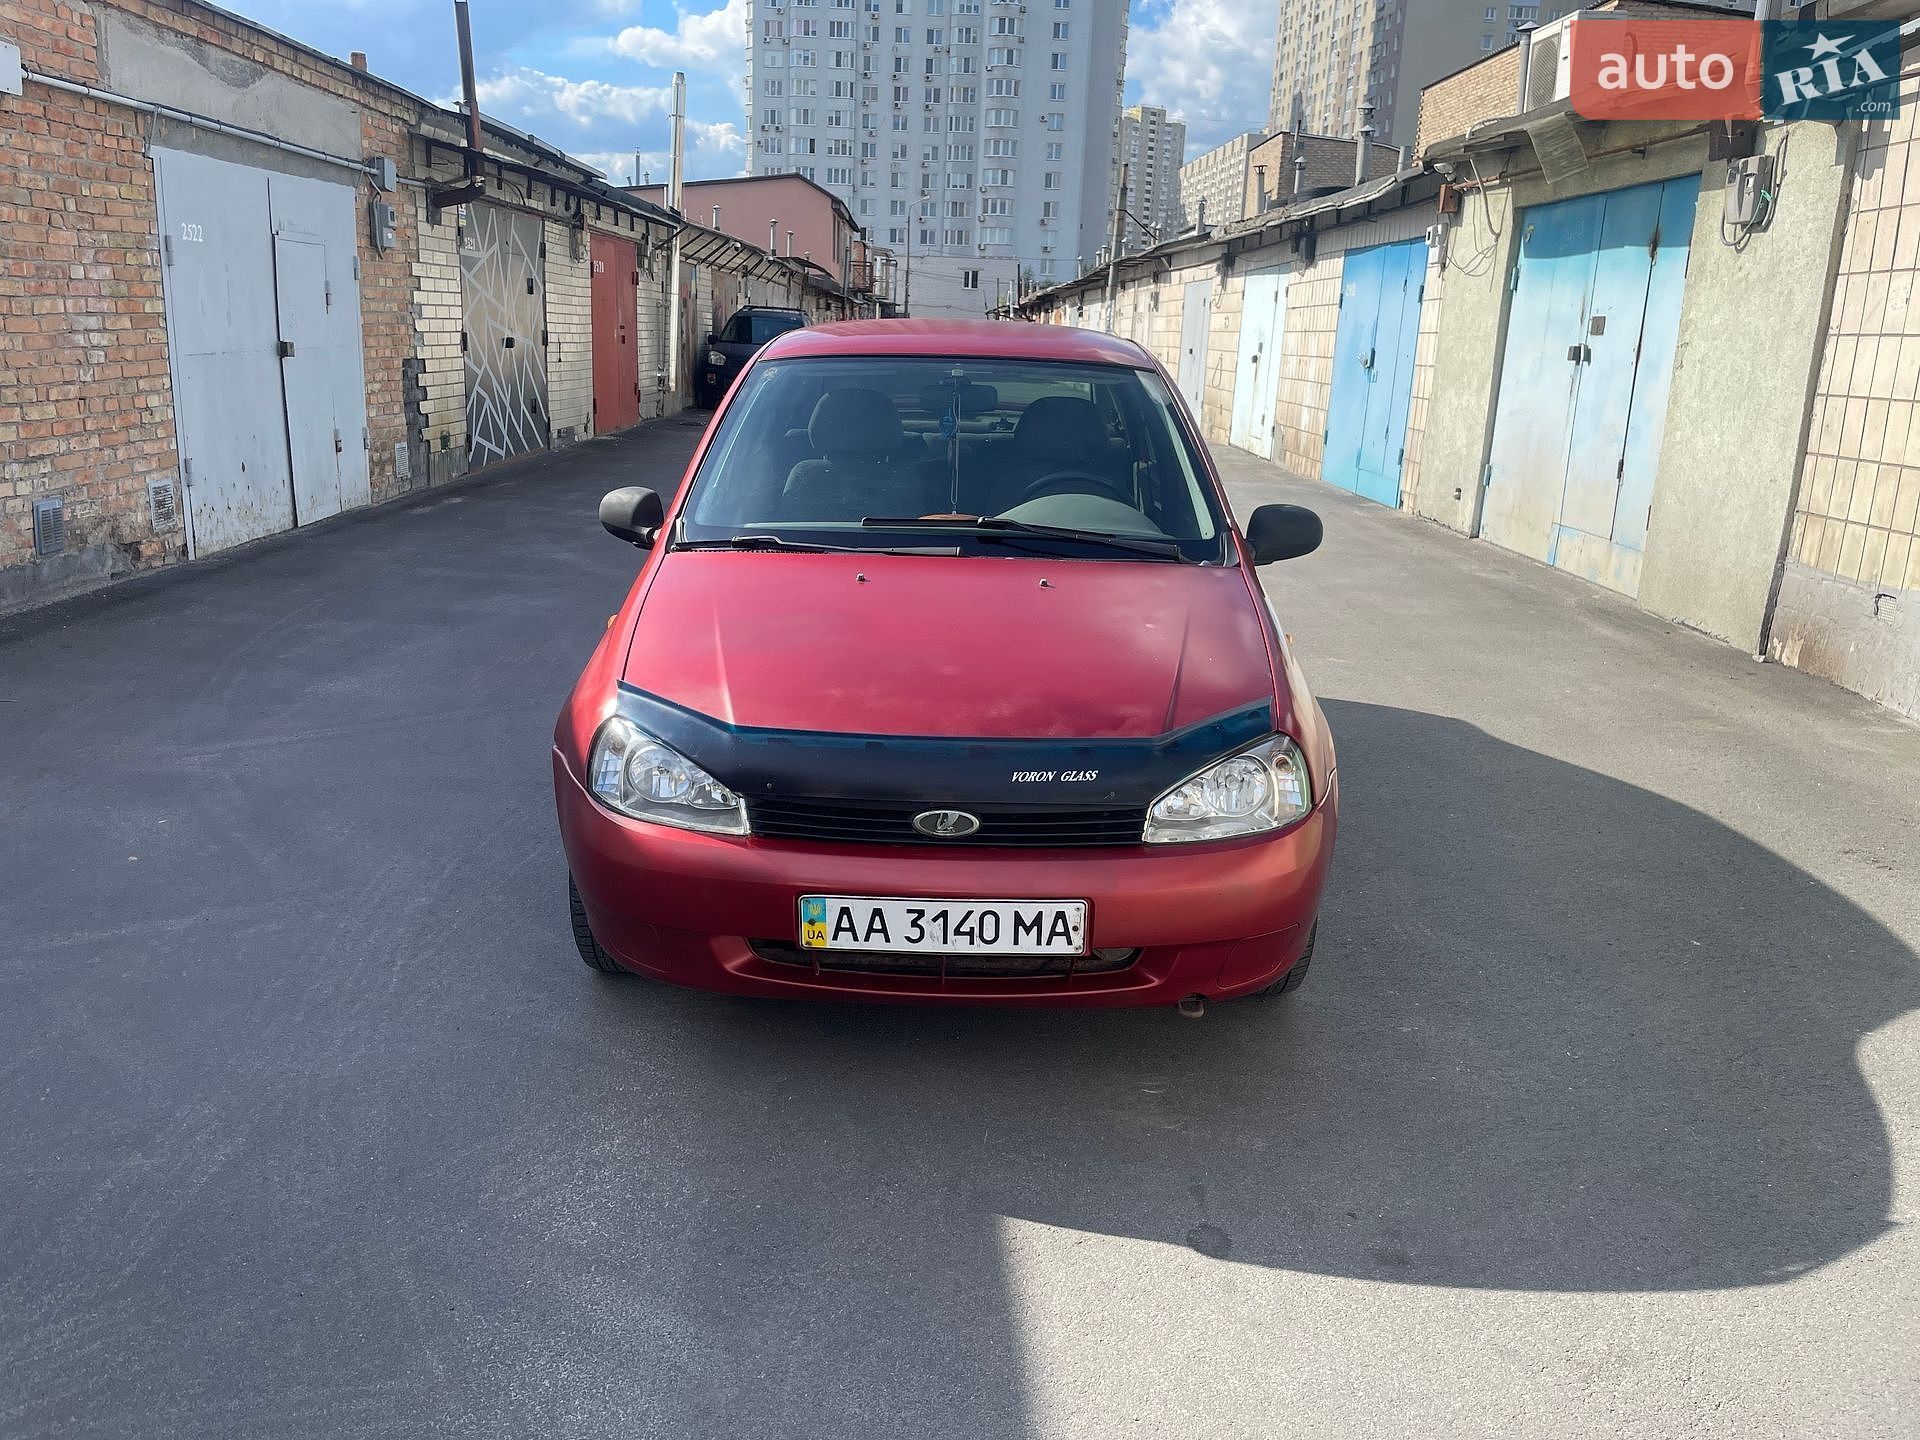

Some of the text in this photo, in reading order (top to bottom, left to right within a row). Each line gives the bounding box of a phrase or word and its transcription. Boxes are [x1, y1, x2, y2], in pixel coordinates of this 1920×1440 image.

[181, 222, 203, 241] 2522
[1012, 770, 1098, 782] VORON GLASS
[832, 906, 1073, 946] AA 3140 MA
[807, 930, 825, 940] UA
